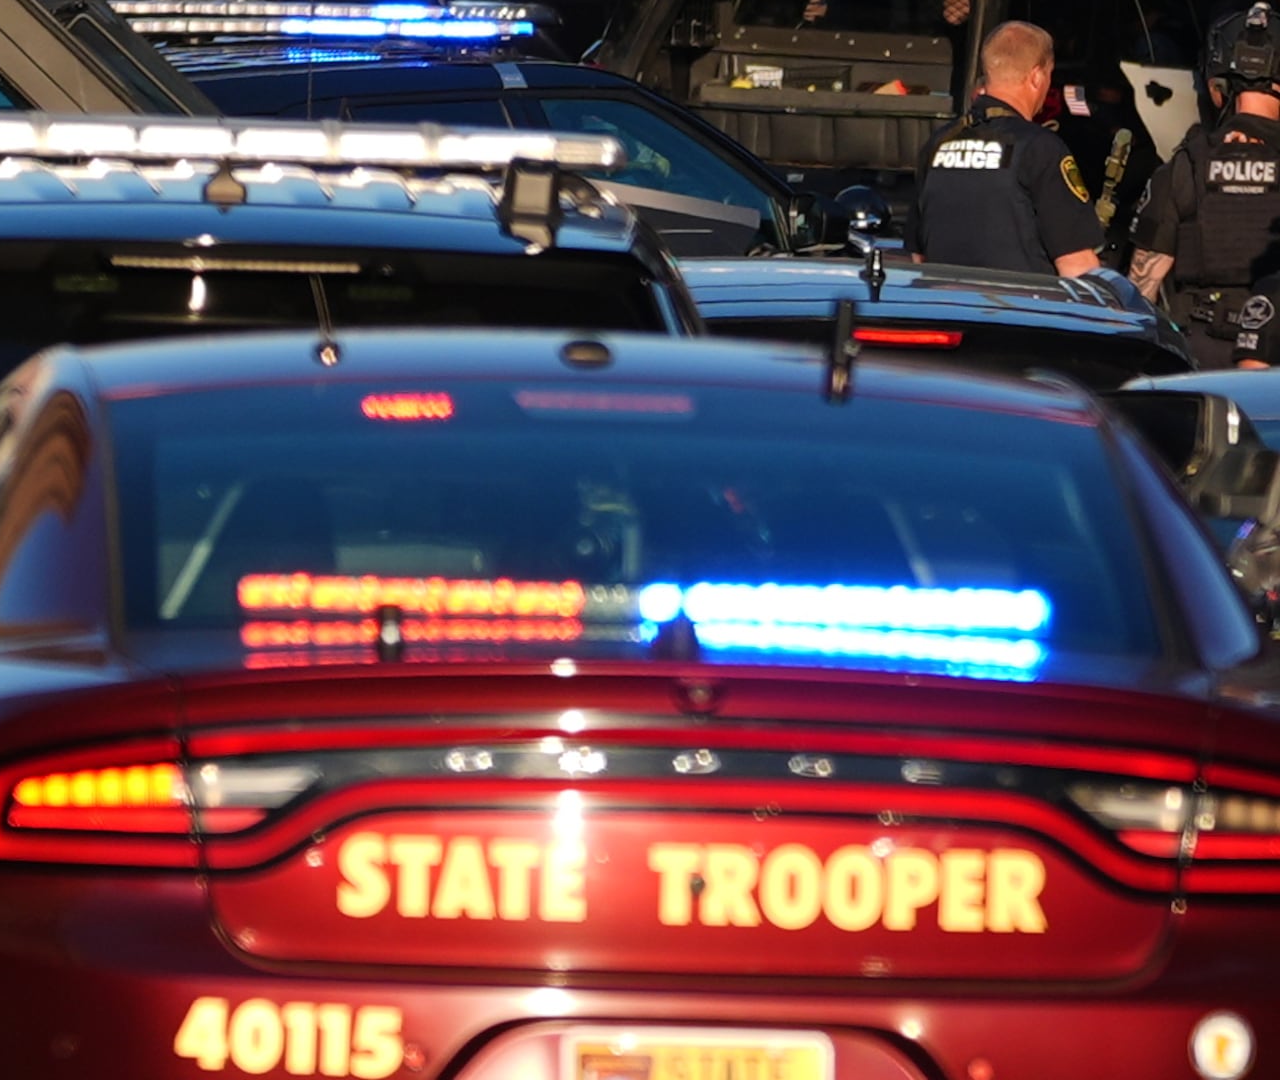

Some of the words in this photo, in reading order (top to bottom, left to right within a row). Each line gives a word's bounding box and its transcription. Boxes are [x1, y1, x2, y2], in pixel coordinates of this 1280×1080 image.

[932, 152, 1002, 169] POLICE
[1209, 160, 1276, 182] POLICE
[338, 832, 588, 923] STATE
[648, 842, 1048, 934] TROOPER
[174, 995, 406, 1080] 40115
